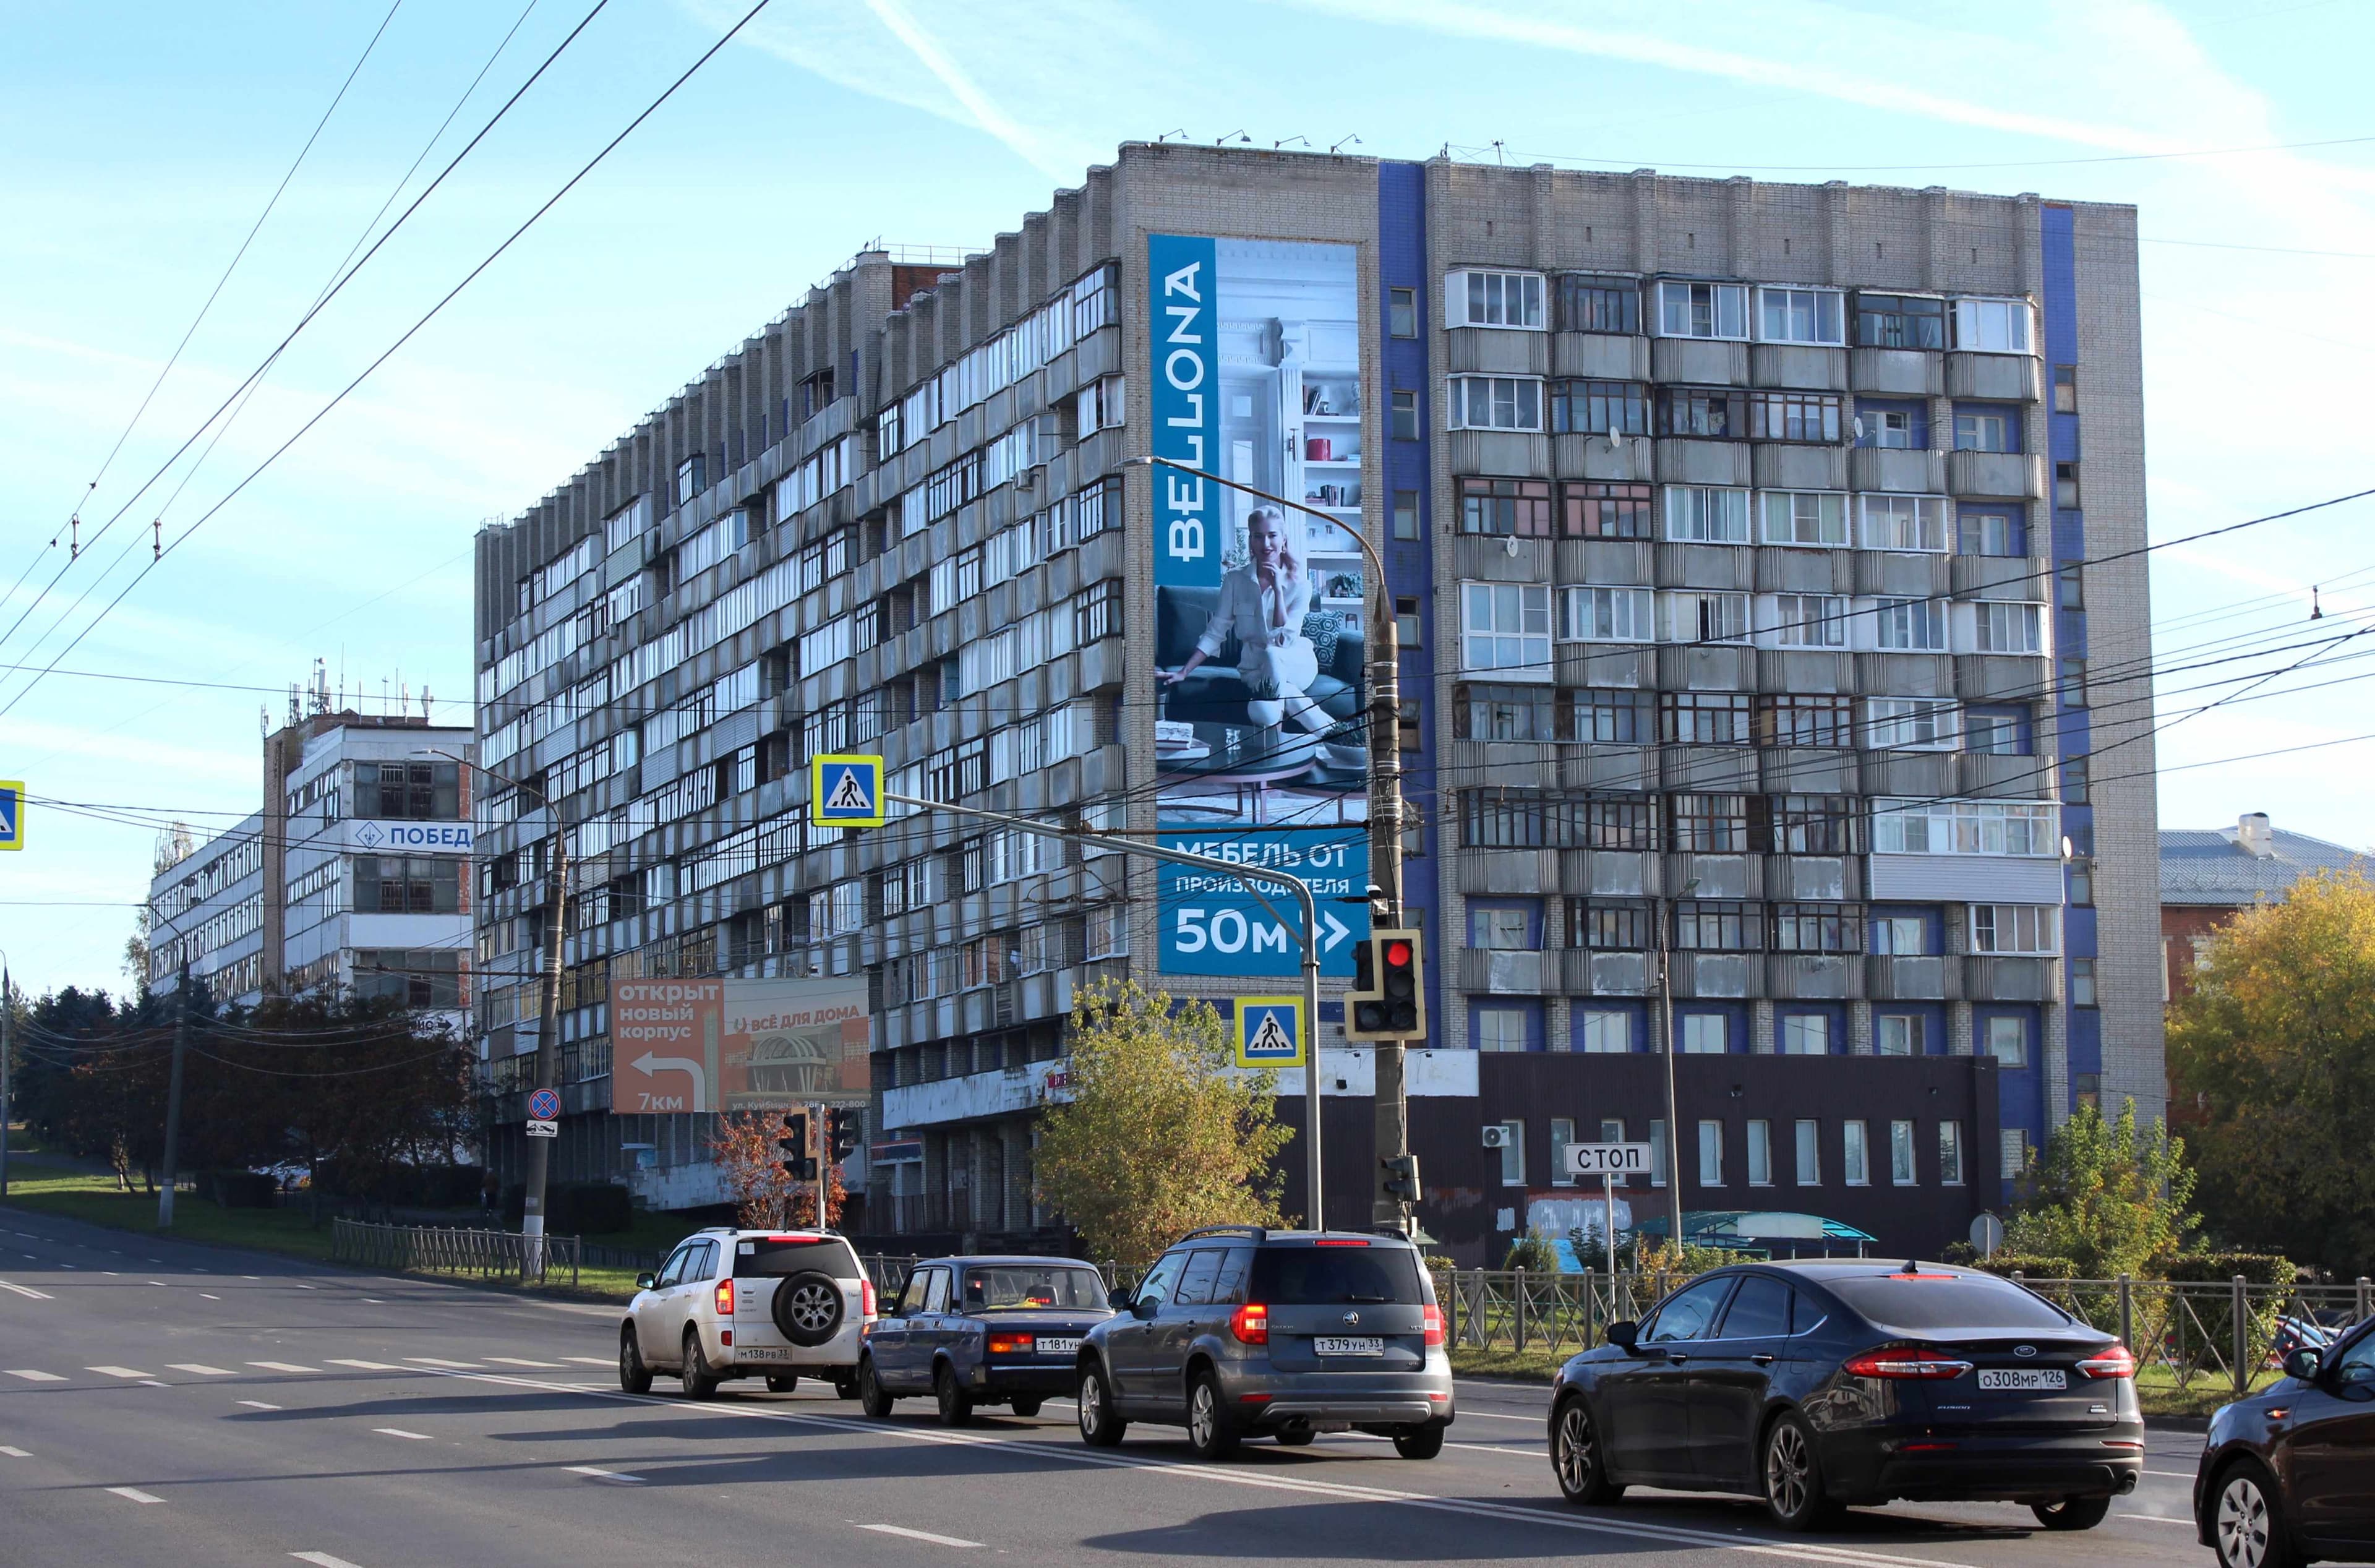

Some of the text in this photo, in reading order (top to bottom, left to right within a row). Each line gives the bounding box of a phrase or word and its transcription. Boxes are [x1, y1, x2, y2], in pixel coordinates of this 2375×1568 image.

[1165, 261, 1205, 562] BELLONA
[391, 828, 474, 847] ПОБЕД
[1176, 841, 1349, 867] МЕБЕЛЬ ОТ
[1176, 876, 1350, 896] ПРОИЗВОДТЕЛЯ
[751, 1005, 860, 1032] ВСЁ ДЛЯ ДОМА
[620, 1026, 692, 1042] корпус
[1578, 1149, 1639, 1168] СТОП
